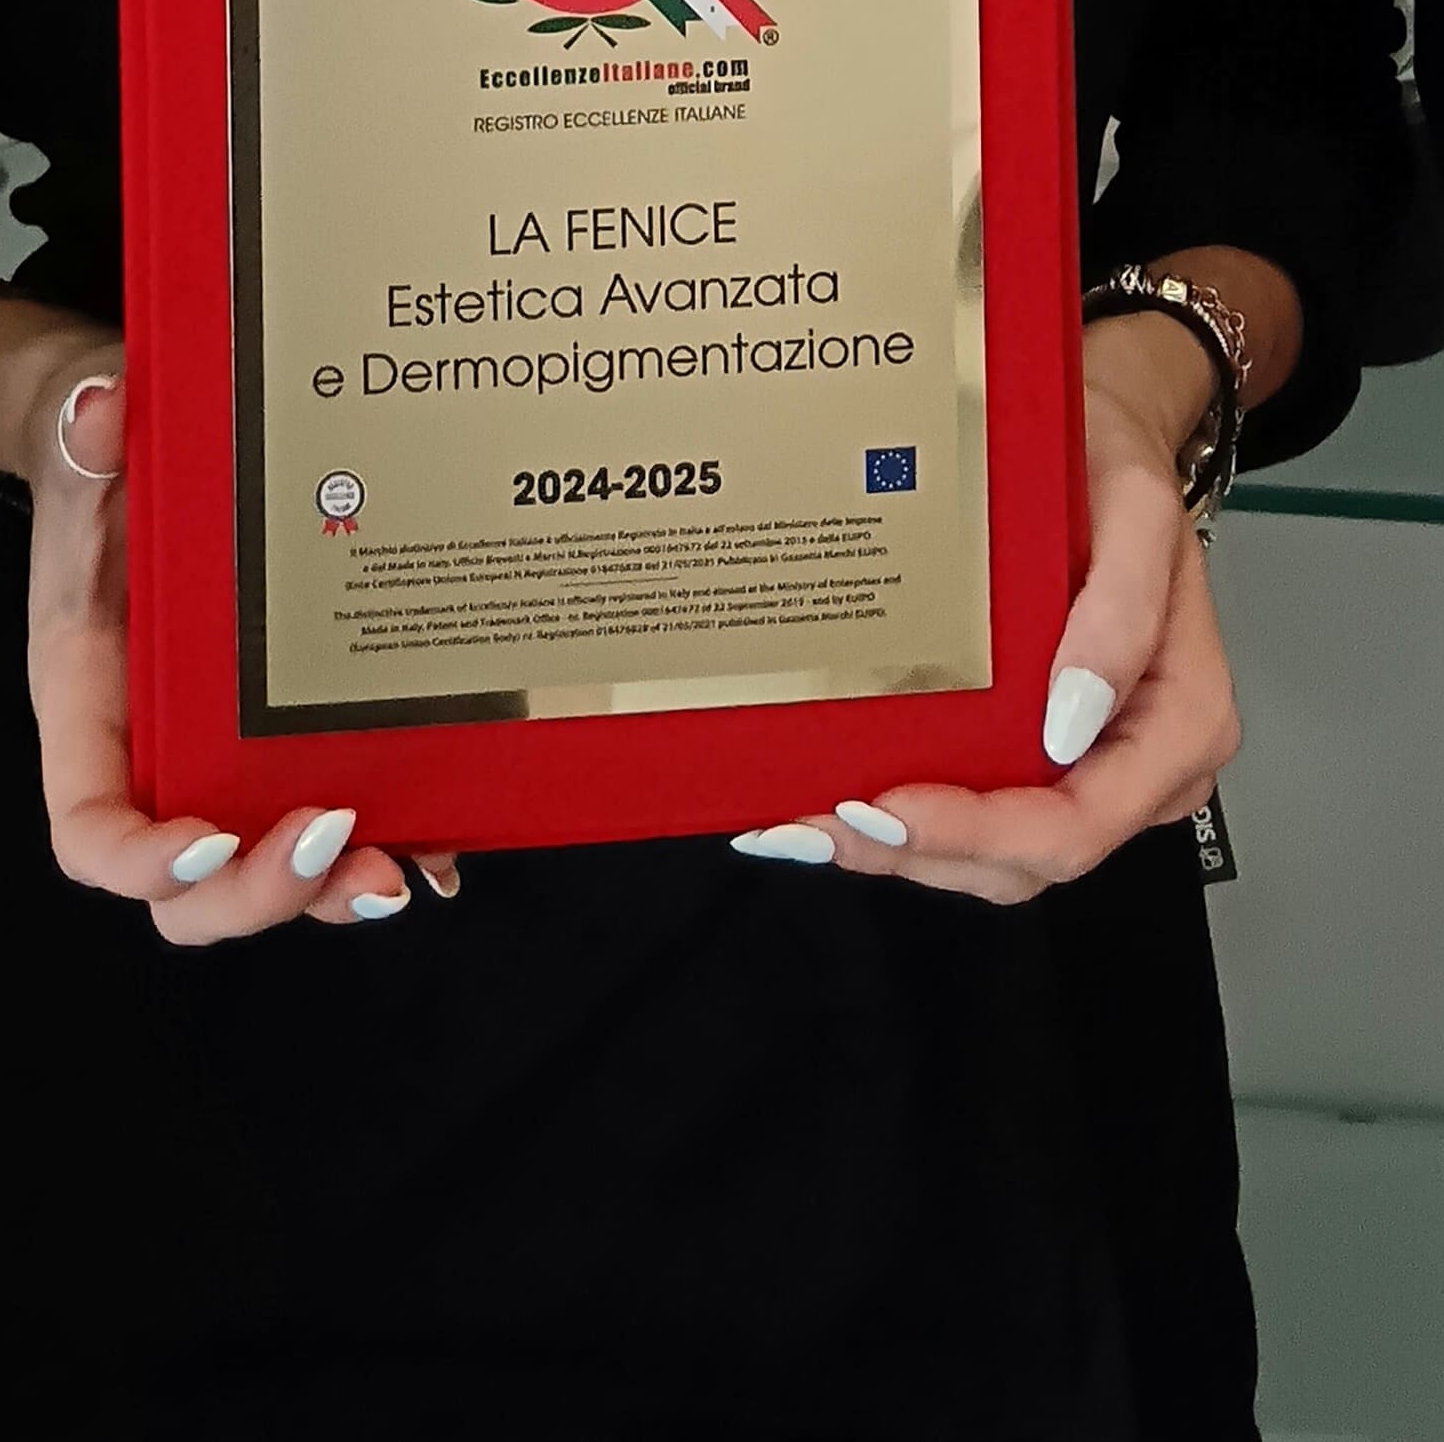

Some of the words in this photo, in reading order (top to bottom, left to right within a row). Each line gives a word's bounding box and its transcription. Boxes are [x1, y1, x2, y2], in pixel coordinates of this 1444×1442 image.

[479, 59, 749, 89] EccellenzeItaliane.com
[473, 113, 559, 134] REGISTRO
[563, 106, 669, 130] ECCELLENZE
[673, 103, 747, 123] ITALIANE
[491, 213, 551, 256] LA
[568, 202, 737, 252] FENICE
[389, 280, 583, 328] Estetica
[600, 264, 839, 316] Avanzata
[314, 366, 345, 399] e
[364, 329, 915, 396] Dermopigmentazione
[514, 461, 722, 507] 2024-2025
